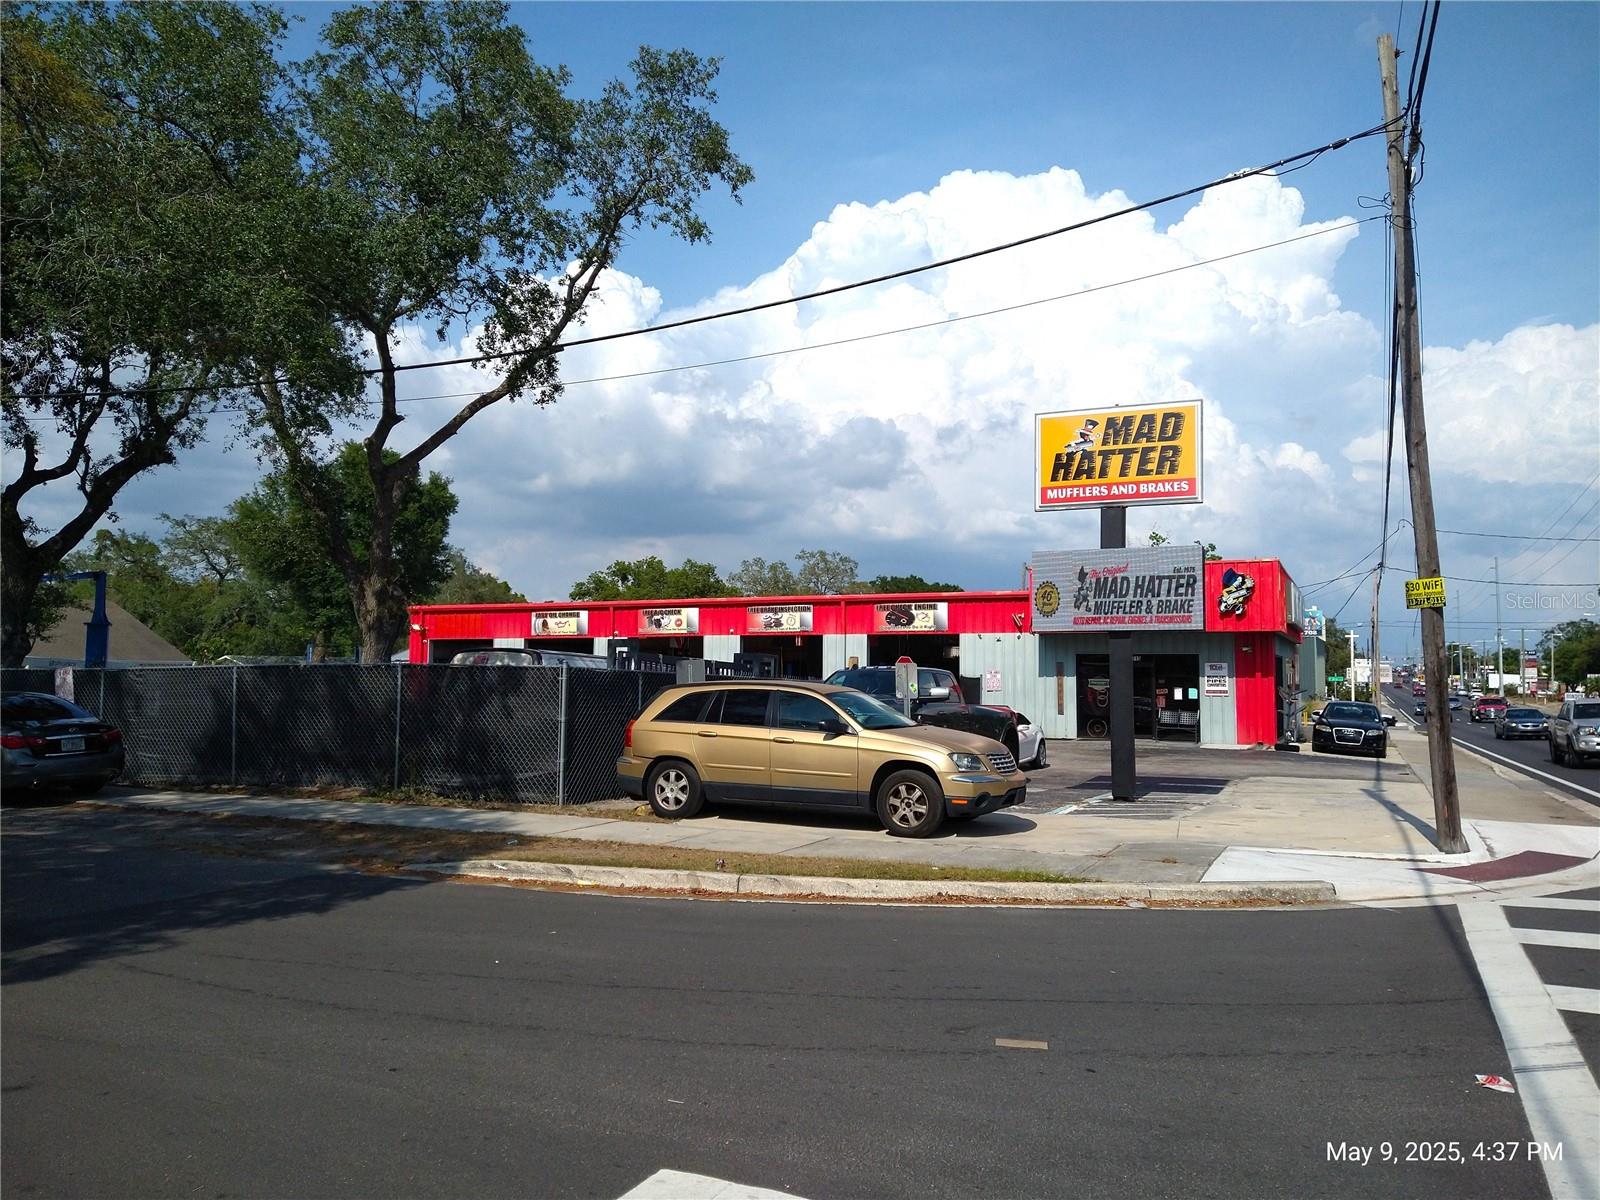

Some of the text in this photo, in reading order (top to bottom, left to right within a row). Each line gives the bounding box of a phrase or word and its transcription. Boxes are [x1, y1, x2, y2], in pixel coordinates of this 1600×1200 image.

[1101, 412, 1185, 446] MAD
[1050, 445, 1182, 482] HATTER
[1047, 480, 1189, 499] MUFFLERS AND BRAKES
[1093, 574, 1197, 600] MAD HATTER
[1405, 579, 1443, 592] $30 WiFi
[1093, 599, 1194, 615] MUFFLER & BRAKE
